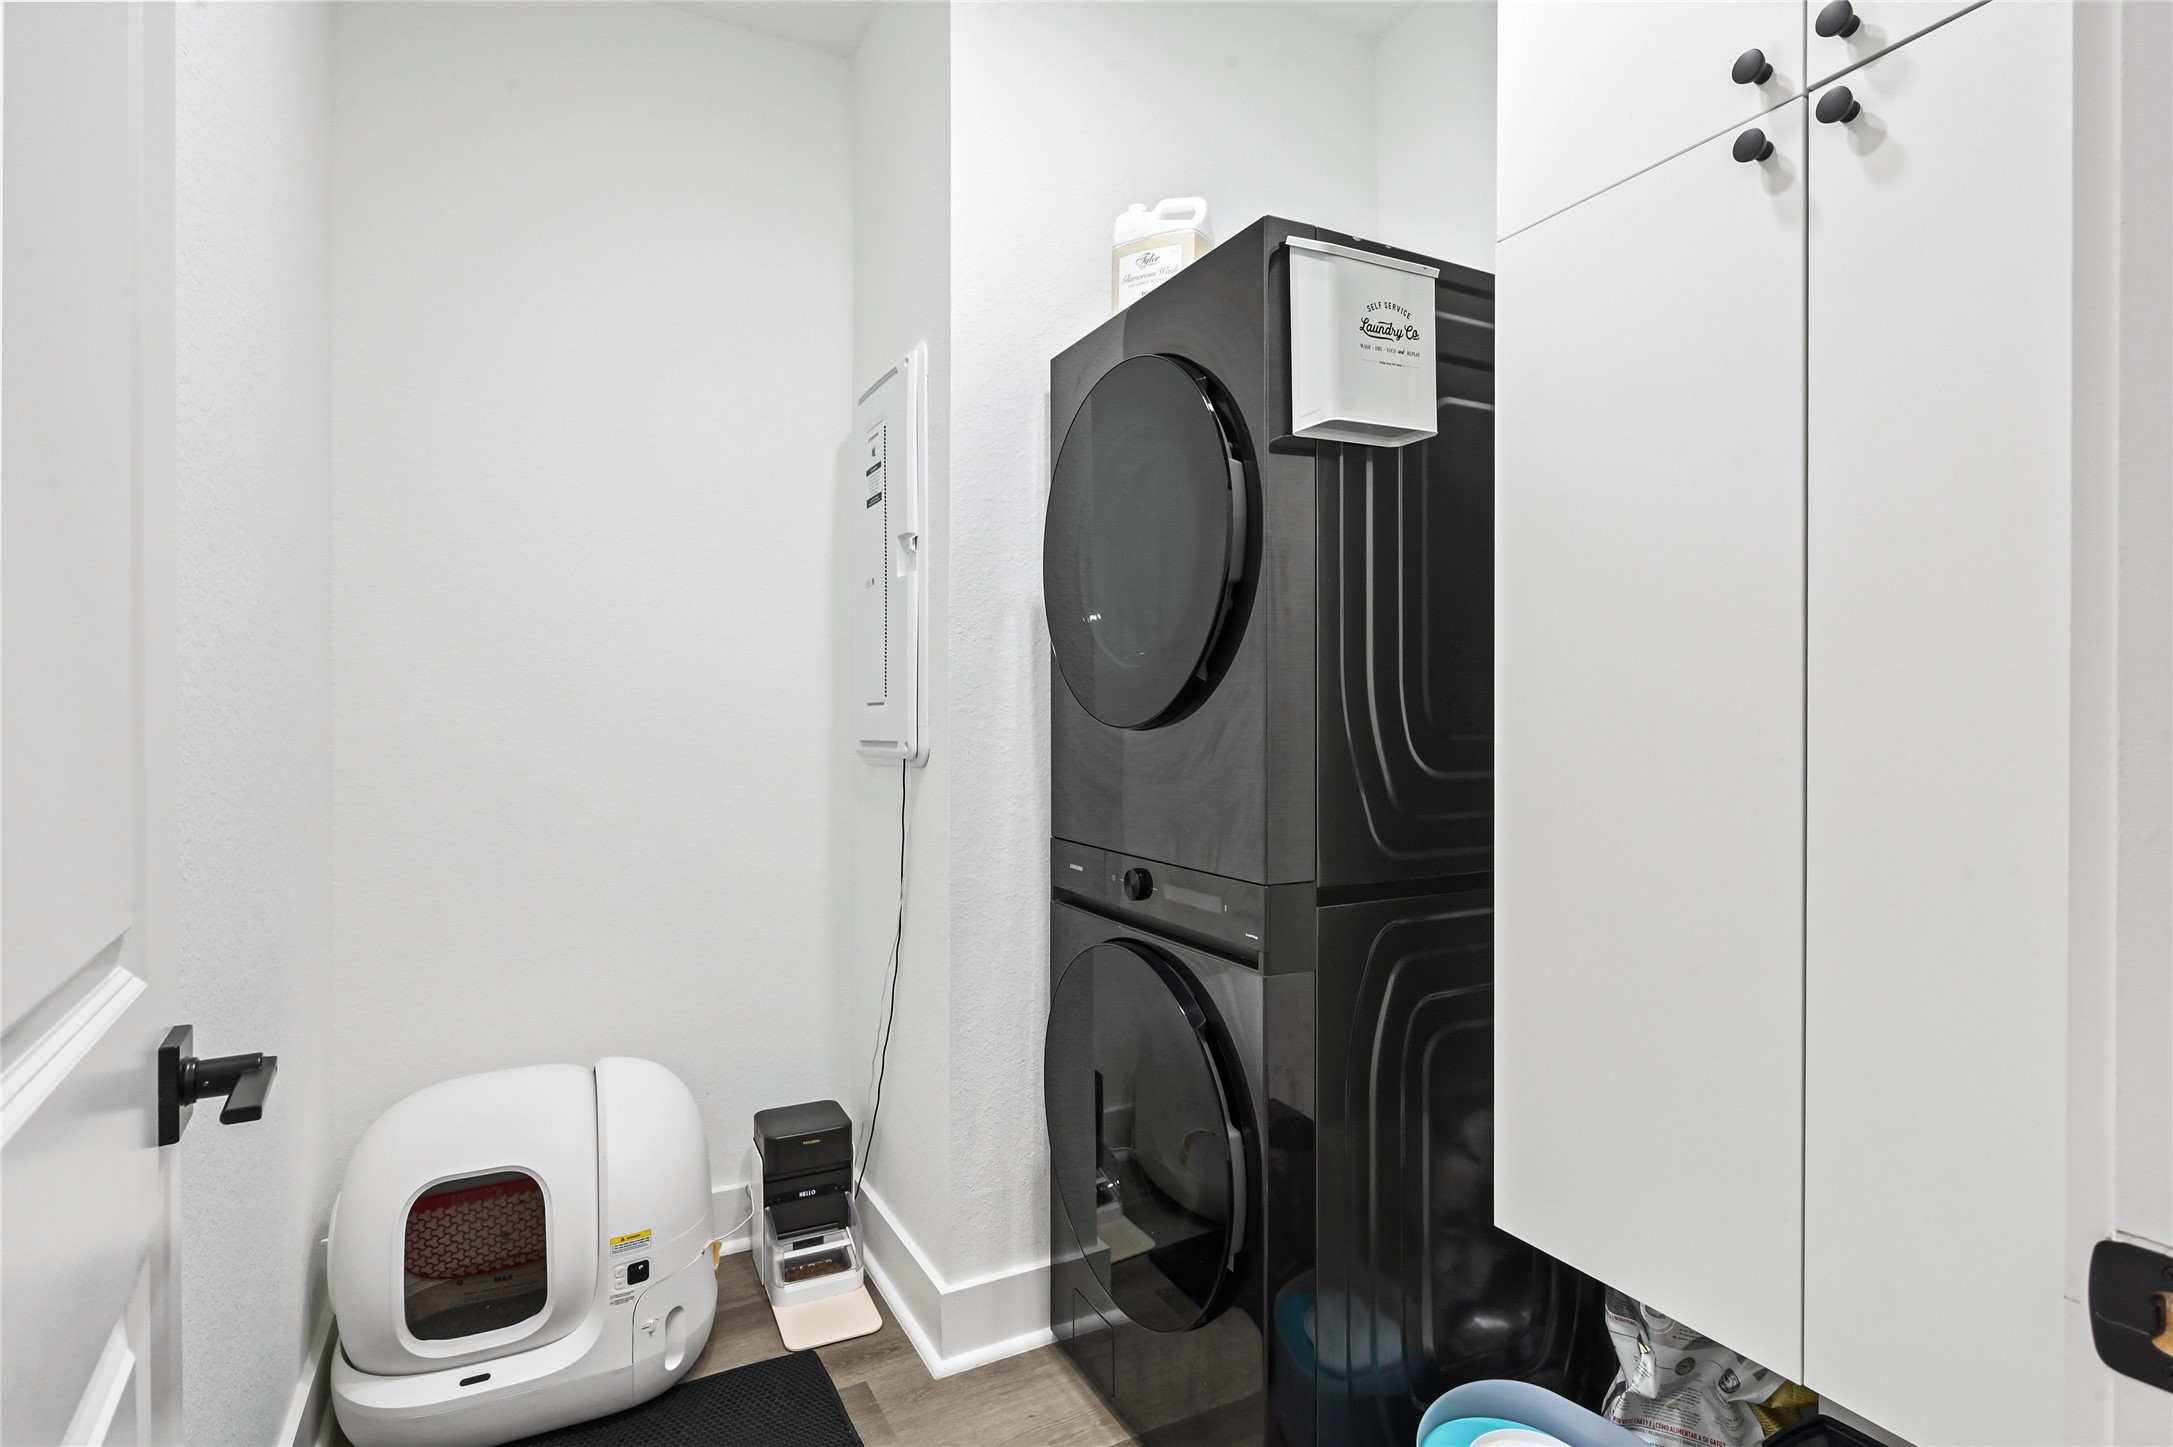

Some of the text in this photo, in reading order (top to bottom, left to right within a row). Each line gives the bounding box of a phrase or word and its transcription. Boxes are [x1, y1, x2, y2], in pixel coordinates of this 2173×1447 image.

[1135, 252, 1160, 270] Tyler
[1121, 264, 1179, 285] Glamorous Wash
[1366, 301, 1412, 320] SELF SERVICE
[1359, 317, 1404, 342] Laundry
[799, 1188, 817, 1198] HELLO
[493, 1274, 513, 1283] MAX
[1669, 1426, 1698, 1441] ALIMENTAR
[1702, 1435, 1710, 1444] SU
[1709, 1438, 1727, 1447] GATO?
